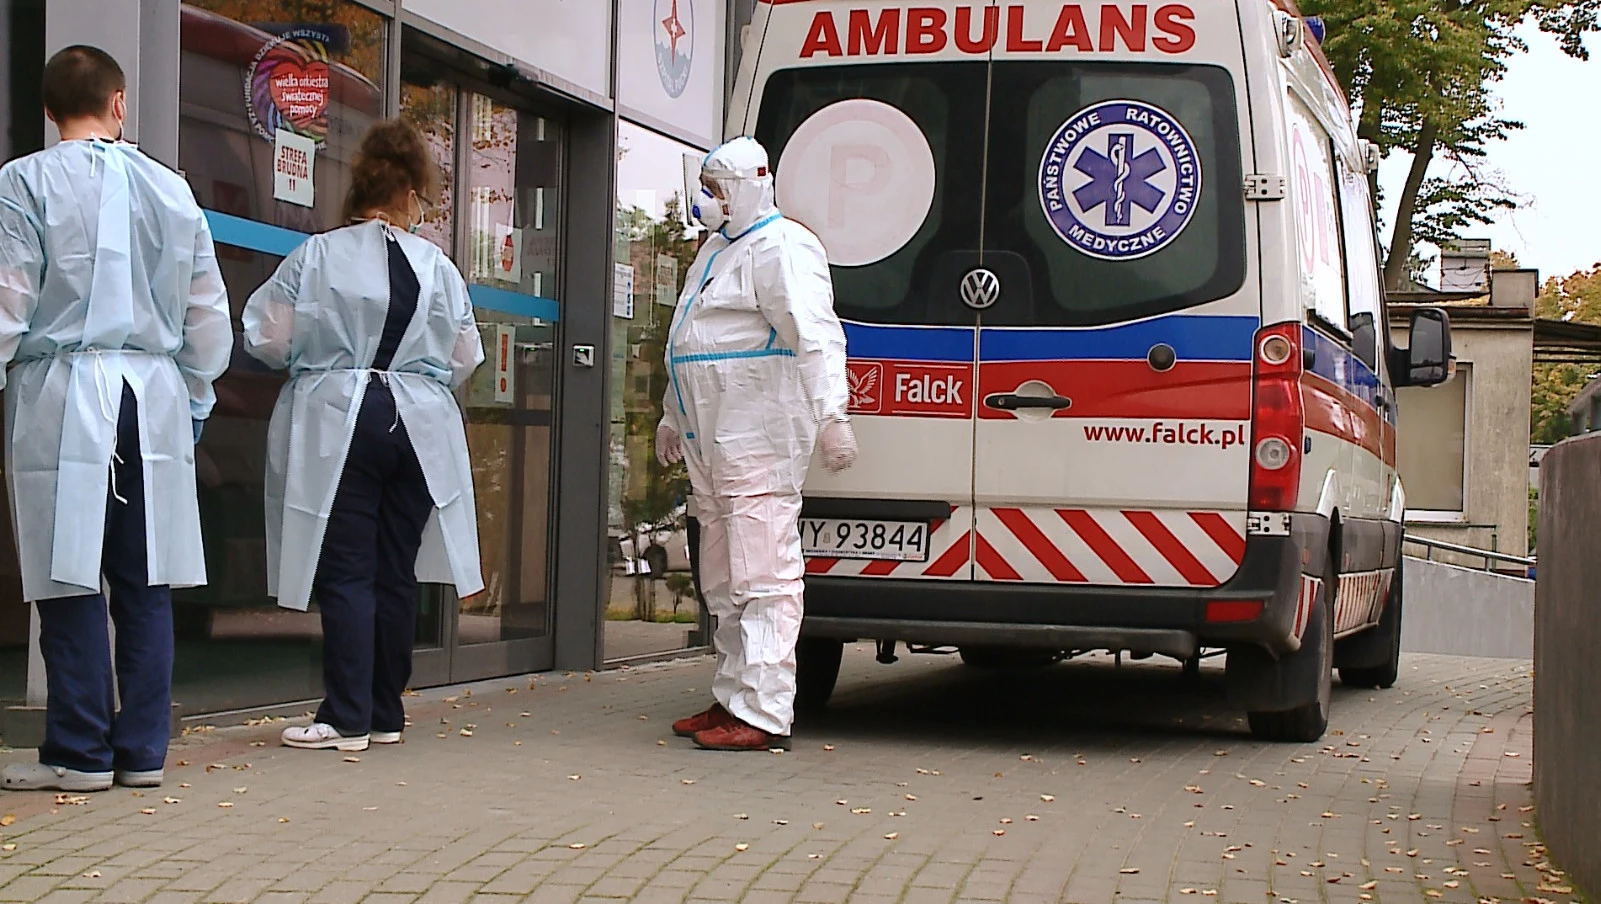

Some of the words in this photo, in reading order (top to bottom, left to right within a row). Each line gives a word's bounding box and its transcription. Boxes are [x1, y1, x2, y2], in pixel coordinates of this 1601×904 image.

[799, 4, 1196, 58] AMBULANS
[275, 73, 298, 88] wielka
[299, 74, 329, 88] orkiestra
[289, 104, 318, 118] pomocy
[277, 159, 309, 180] BRUDNA
[281, 145, 308, 166] STREFA
[1043, 112, 1101, 212] PAŃSTWOWE
[1126, 107, 1194, 215] RATOWNICTWO
[1068, 224, 1166, 252] MEDYCZNE
[895, 373, 963, 405] Falck
[1083, 422, 1245, 450] www.falck.pl
[836, 522, 923, 552] 93844
